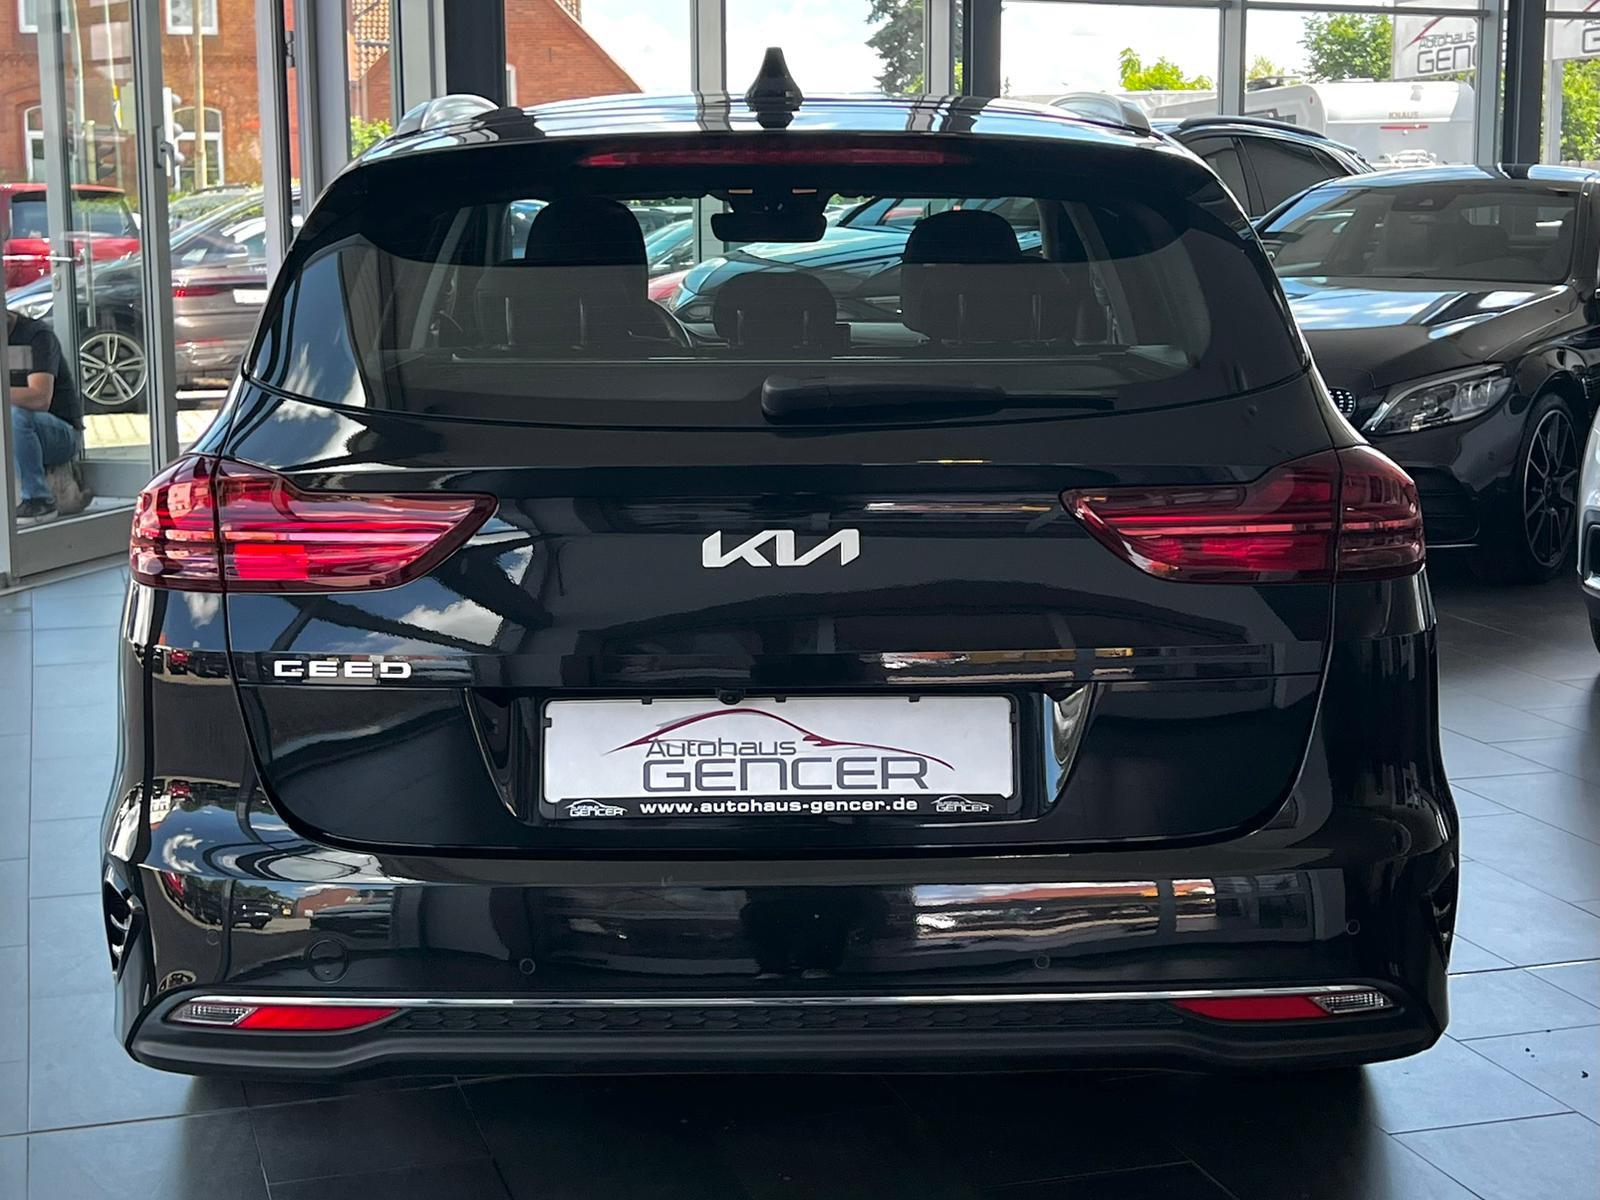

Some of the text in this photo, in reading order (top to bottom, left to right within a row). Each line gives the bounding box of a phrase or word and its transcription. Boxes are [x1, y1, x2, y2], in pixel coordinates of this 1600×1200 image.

[1417, 45, 1476, 74] GEN
[702, 528, 861, 568] KIA
[645, 737, 797, 758] Autohaus
[642, 756, 929, 792] GENCER
[639, 797, 919, 815] www.autohaus-gencer.de
[936, 804, 989, 812] GENCER
